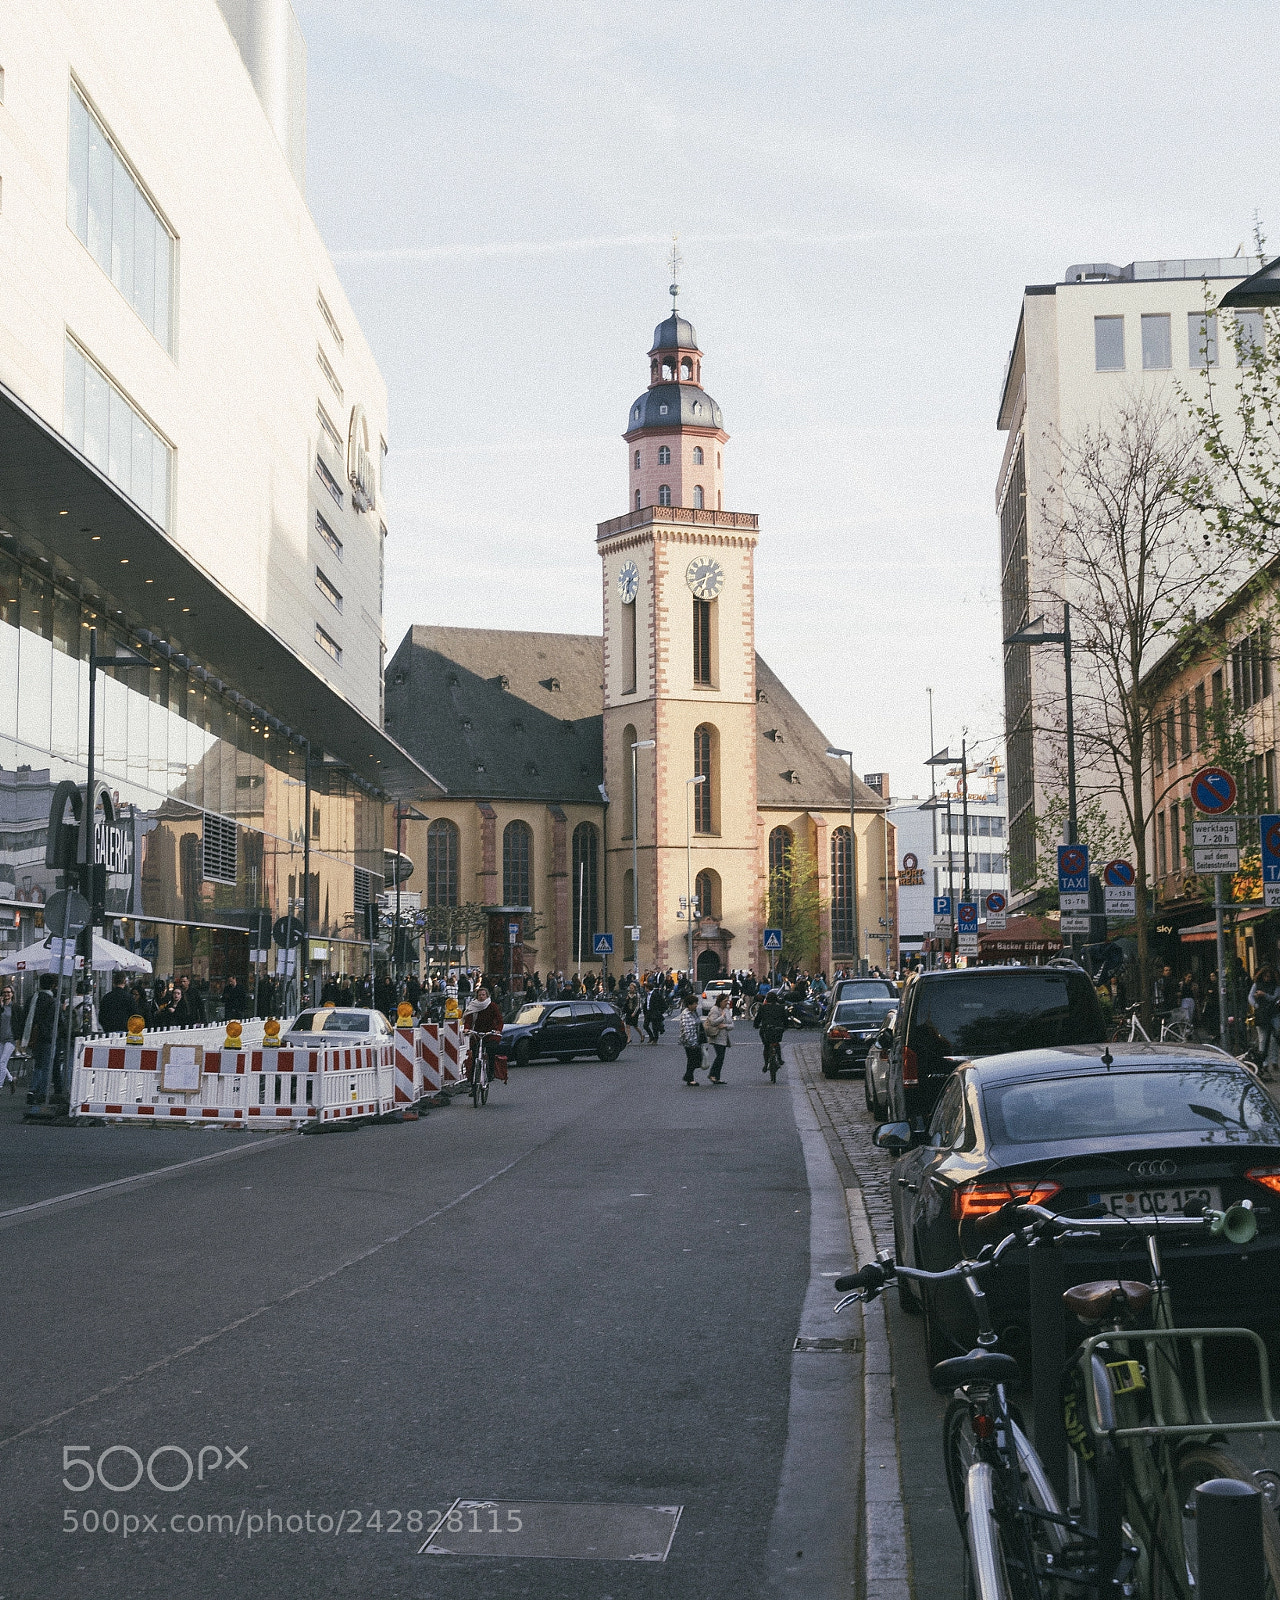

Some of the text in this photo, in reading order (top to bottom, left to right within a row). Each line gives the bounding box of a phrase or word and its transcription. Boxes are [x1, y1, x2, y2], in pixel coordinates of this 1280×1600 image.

[1195, 824, 1234, 834] werktags
[1214, 835, 1223, 843] 20
[1224, 835, 1229, 843] h
[94, 823, 129, 873] GALERIA
[1196, 861, 1236, 870] Seitenstreifen
[899, 877, 925, 886] RENA
[1061, 878, 1086, 888] TAXI
[937, 900, 947, 912] P
[960, 923, 977, 931] TAXI
[1156, 925, 1173, 935] sky
[1110, 1195, 1124, 1213] F
